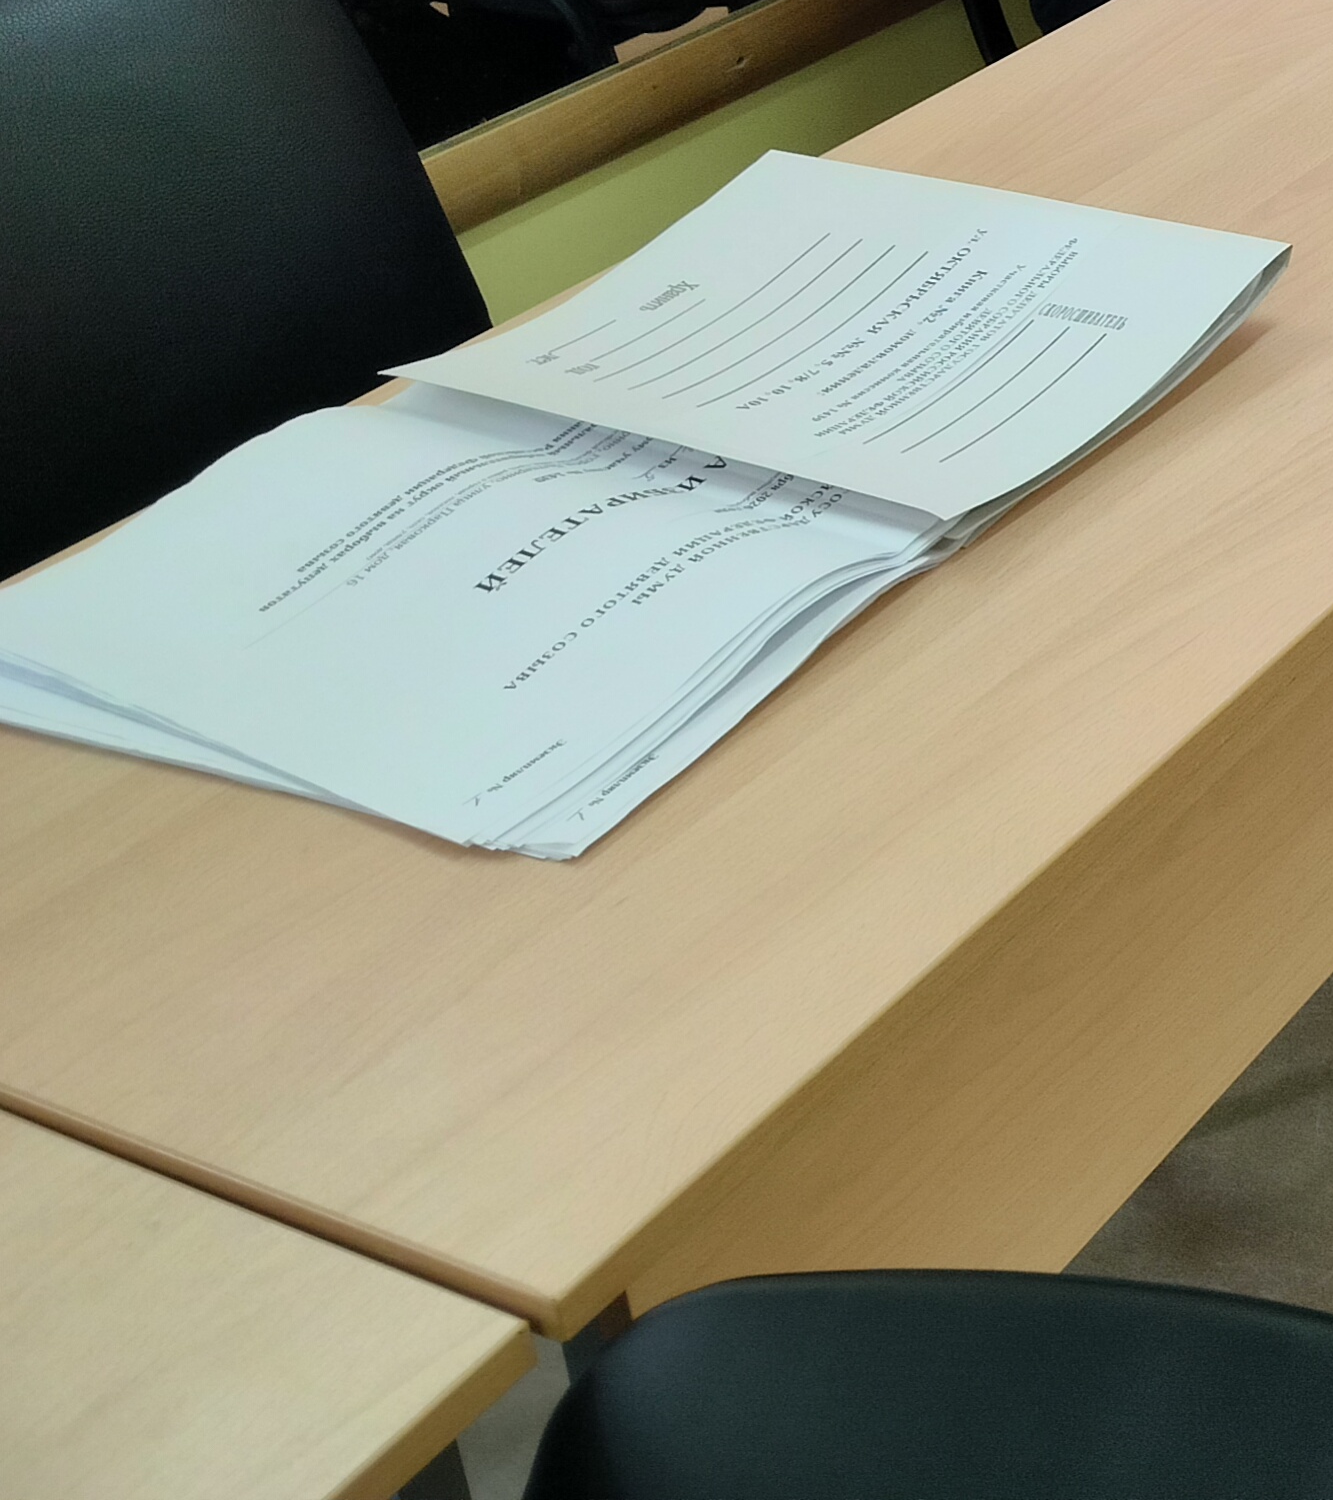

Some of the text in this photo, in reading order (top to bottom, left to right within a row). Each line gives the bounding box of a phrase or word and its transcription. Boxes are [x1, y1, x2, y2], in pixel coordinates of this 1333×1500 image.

[965, 228, 989, 244] ул.
[635, 279, 700, 311] Хранить
[865, 247, 972, 335] ОКТЯБРЬСКАЯ
[944, 269, 989, 304] Книга
[968, 263, 1027, 311] Участковая
[812, 237, 1078, 437] ФЕДЕРАЛЬНОГО СОБРАНИЯ РОССИЙСКОЙ ФЕДЕРАЦИИ
[1033, 301, 1134, 331] СКОРОСШИВАТЕЛЬ
[836, 250, 1079, 435] ВЫБОРЫ ДЕПУТАТОВ ГОСУДАРСТВЕННОЙ ДУМЫ
[895, 307, 994, 382] ДЕВЯТОГО СОЗЫВА
[898, 311, 974, 367] избирательная
[811, 358, 836, 366] 5,
[814, 328, 917, 397] домовладения:
[763, 384, 793, 395] 10,
[849, 367, 901, 400] комиссия
[809, 407, 840, 422] 1439
[384, 507, 406, 520] на
[405, 481, 445, 507] округ
[450, 482, 493, 507] улица
[344, 496, 404, 537] девятого
[386, 507, 455, 551] Парковая,
[472, 474, 707, 594] ИЗБИРАТЕЛЕЙ
[294, 537, 347, 573] созыва
[327, 520, 388, 563] выборах
[362, 551, 392, 573] дом
[257, 562, 328, 612] депутатов
[343, 573, 365, 587] 16
[576, 556, 671, 627] ДЕВЯТОГО
[629, 562, 684, 605] ДУМЫ
[502, 631, 580, 689] СОЗЫВА
[486, 738, 567, 793] Экземпляр №
